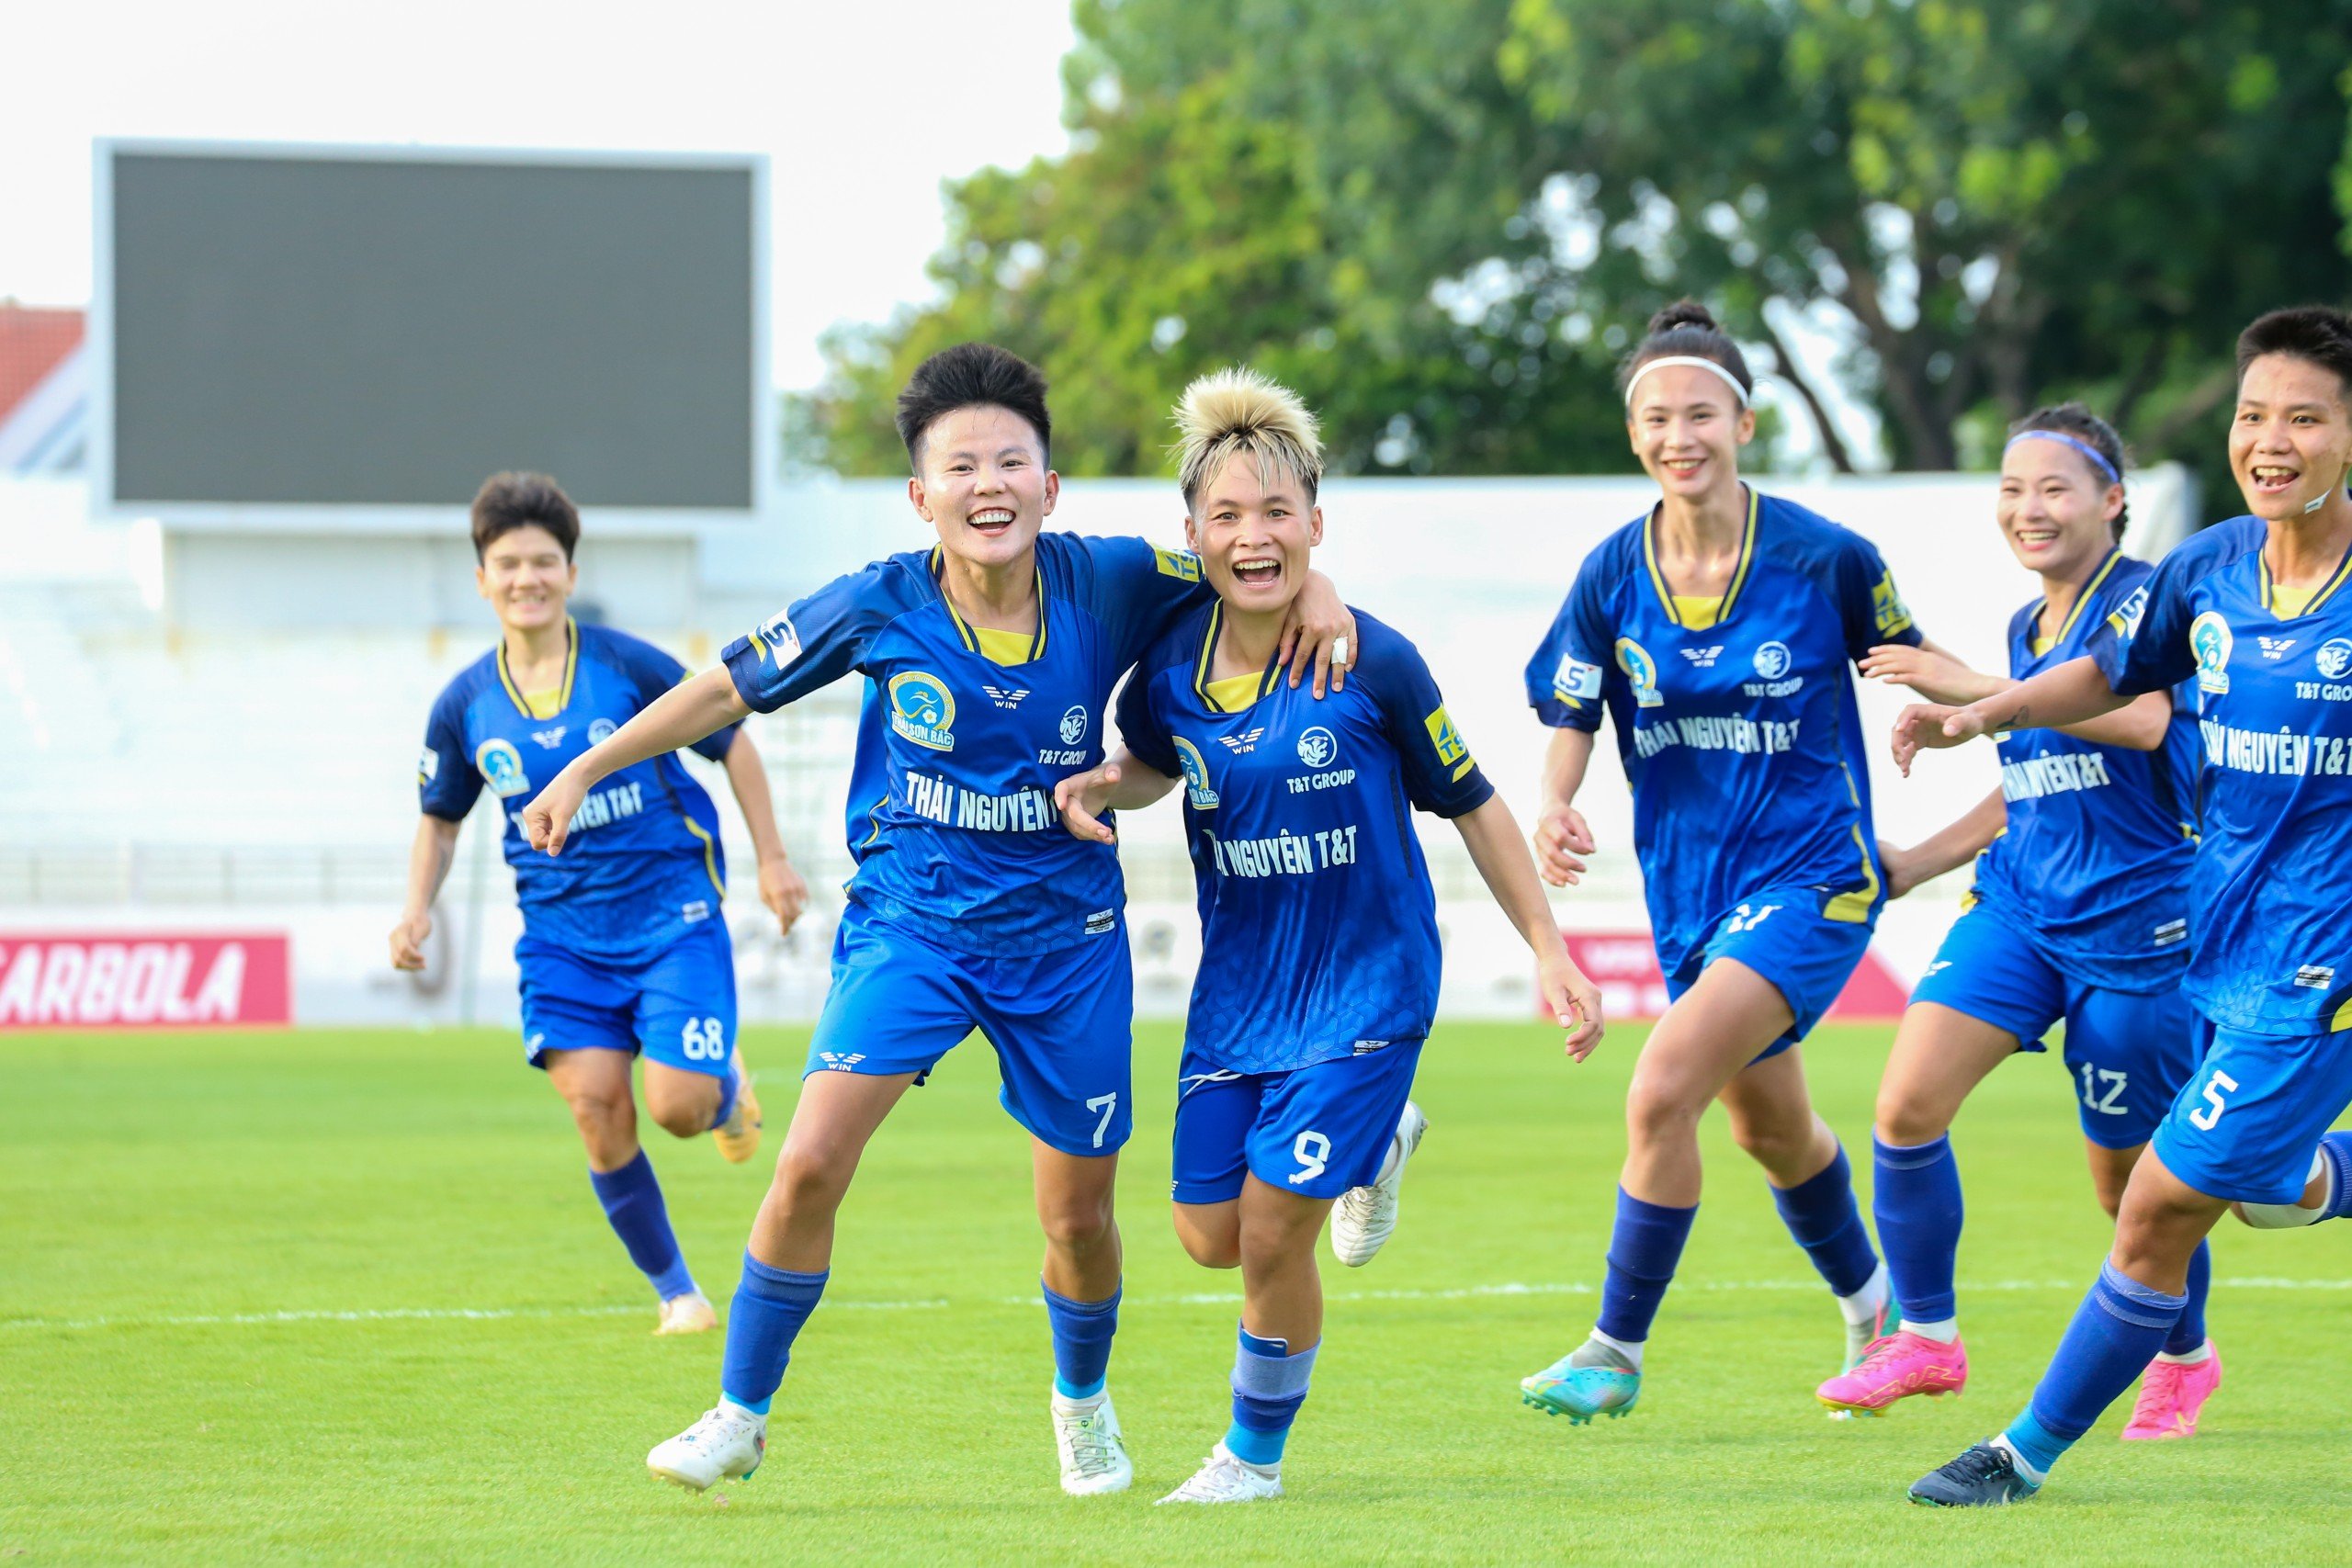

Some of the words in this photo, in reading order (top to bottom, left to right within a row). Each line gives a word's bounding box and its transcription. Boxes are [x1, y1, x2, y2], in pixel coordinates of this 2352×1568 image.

[1692, 659, 1715, 668] WIN
[994, 700, 1017, 709] WIN
[2295, 682, 2320, 699] T&T
[2322, 683, 2352, 702] GRO
[1232, 743, 1254, 755] WIN
[1677, 712, 1761, 754] NGUYÊN
[1761, 718, 1801, 755] T&T
[2227, 725, 2311, 776] NGUYÊN
[1038, 749, 1061, 765] T&T
[906, 772, 954, 825] THÁI
[956, 785, 1050, 832] NGUYÊN
[1286, 775, 1310, 795] T&T
[1312, 769, 1356, 791] GROUP
[1224, 829, 1314, 878] NGUYÊN
[1315, 825, 1357, 869] T&T
[0, 941, 247, 1023] ARBOLA
[682, 1016, 725, 1061] 68
[828, 1063, 852, 1072] WIN
[2081, 1062, 2128, 1115] 12
[1086, 1092, 1116, 1148] 7
[2188, 1069, 2239, 1132] 5
[1289, 1130, 1331, 1184] 9
